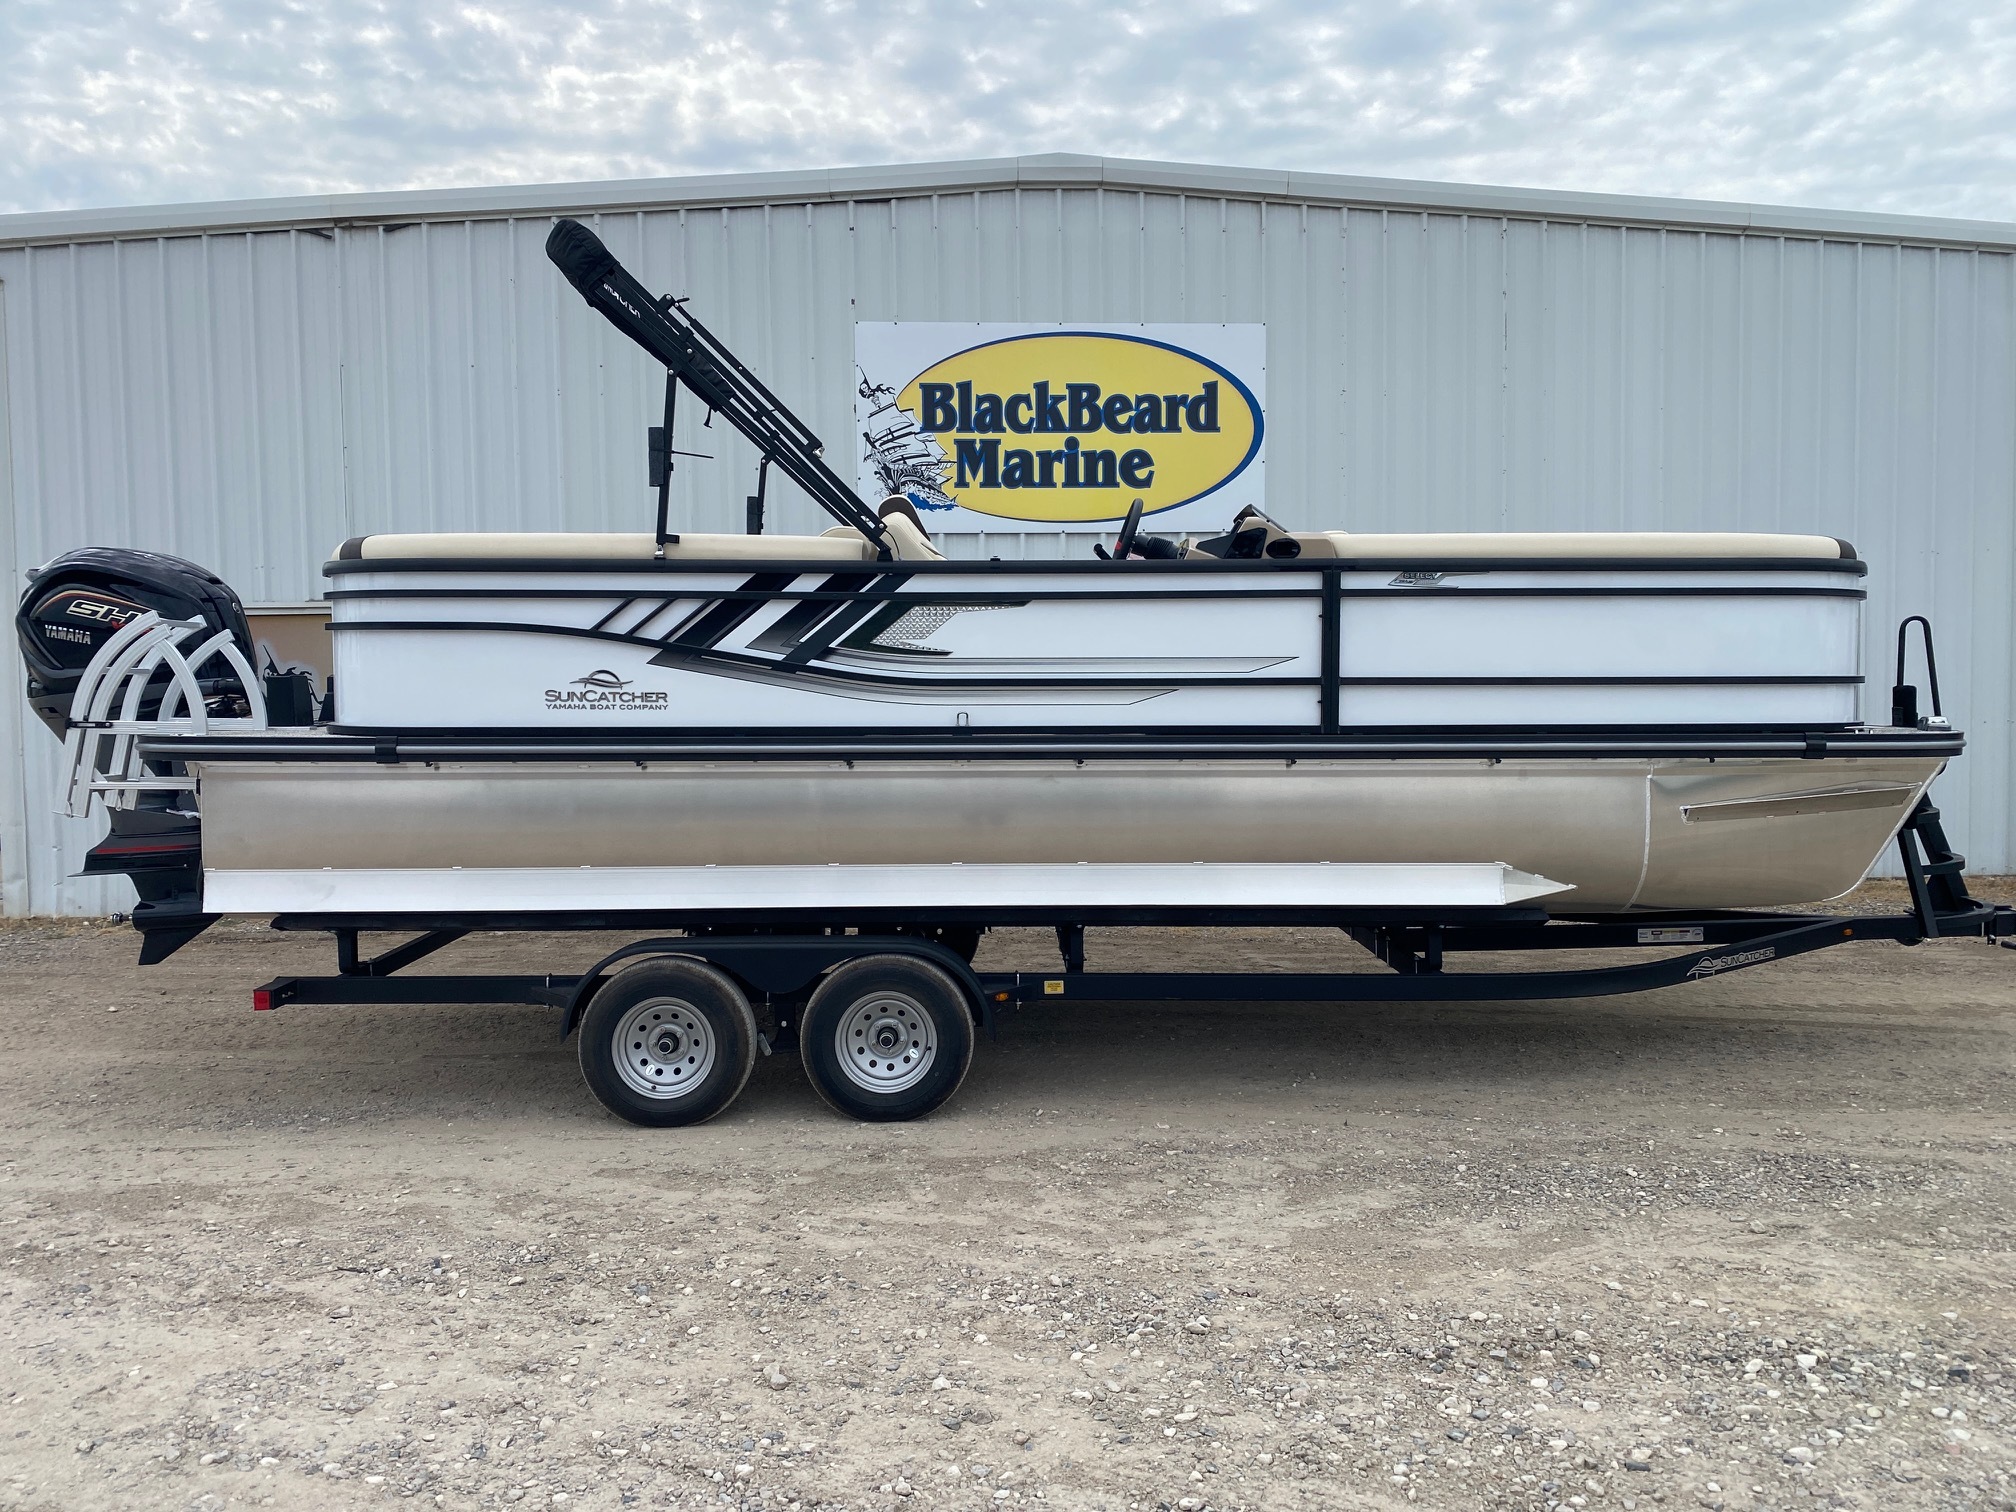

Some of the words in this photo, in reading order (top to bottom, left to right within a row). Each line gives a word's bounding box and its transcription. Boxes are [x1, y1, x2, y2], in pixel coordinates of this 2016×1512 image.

[919, 380, 1221, 434] BlackBeard
[953, 436, 1155, 489] Marine
[45, 624, 91, 645] YAMAHA
[544, 689, 669, 703] SUNCATCHER
